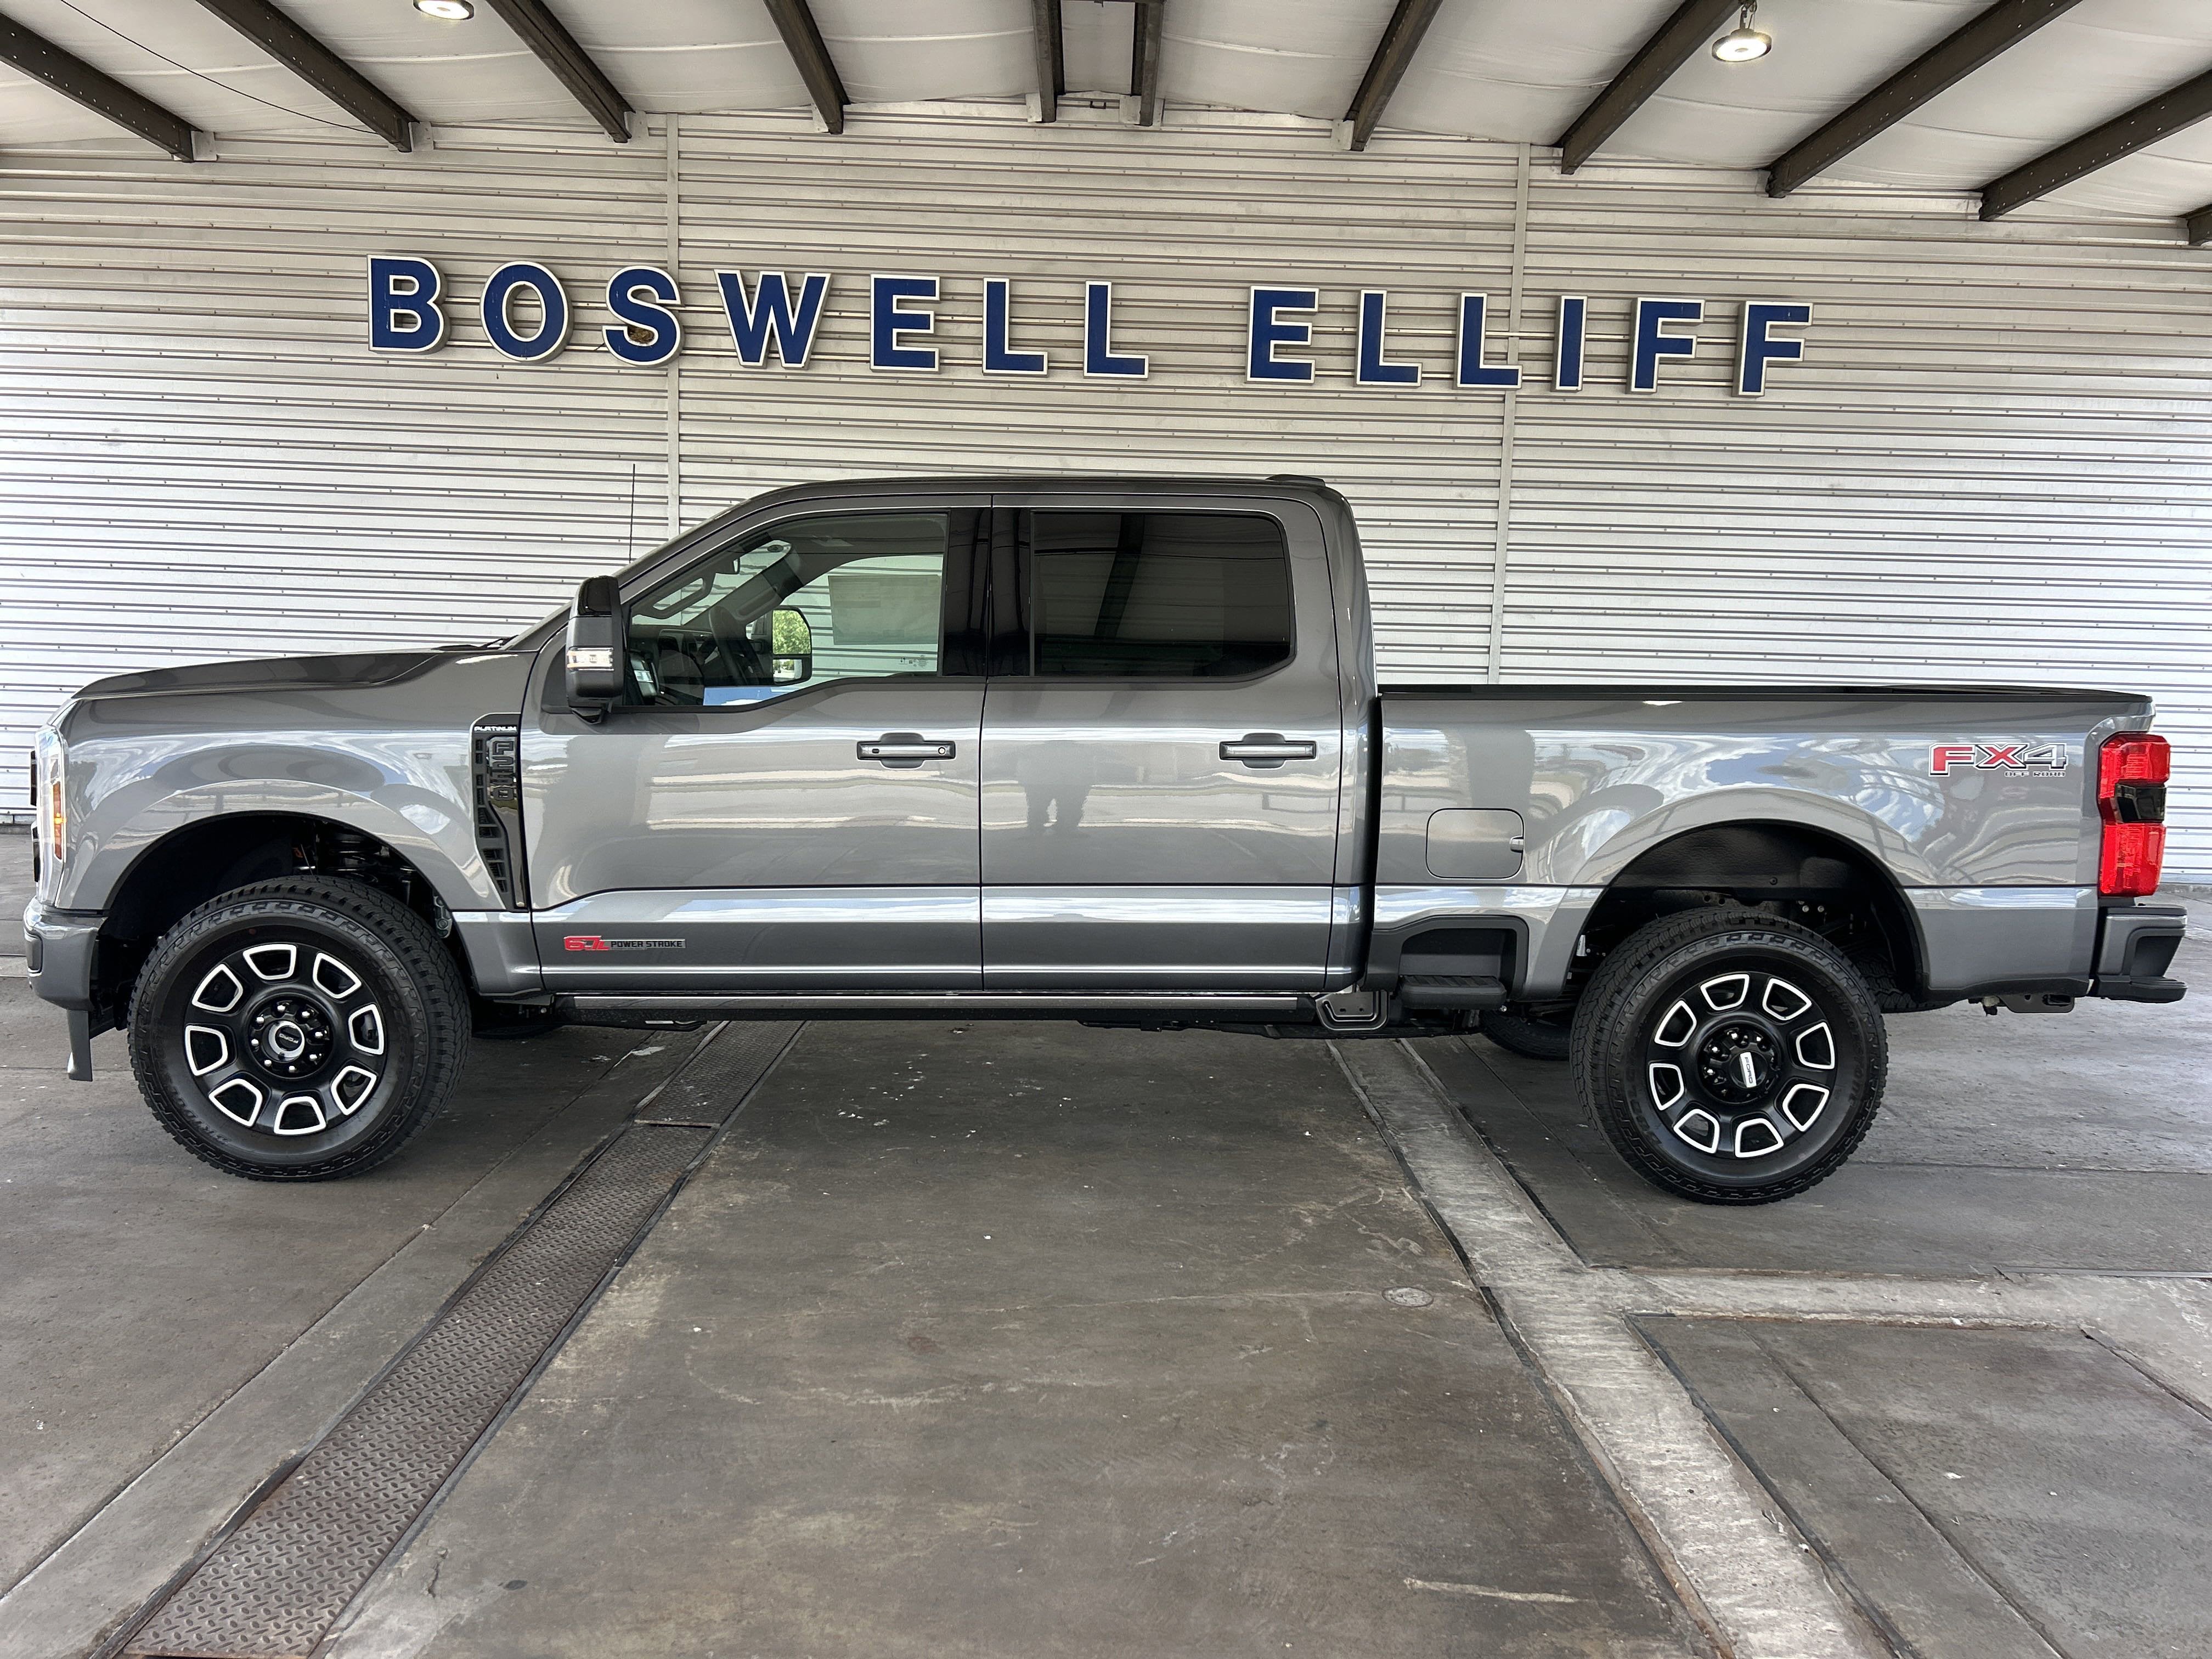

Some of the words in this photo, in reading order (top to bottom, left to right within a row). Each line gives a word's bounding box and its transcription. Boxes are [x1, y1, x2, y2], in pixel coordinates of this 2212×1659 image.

[368, 255, 1149, 380] BOSWELL
[1246, 285, 1813, 396] ELLIFF
[1928, 742, 2068, 776] FX4
[1744, 1057, 1753, 1084] FORD
